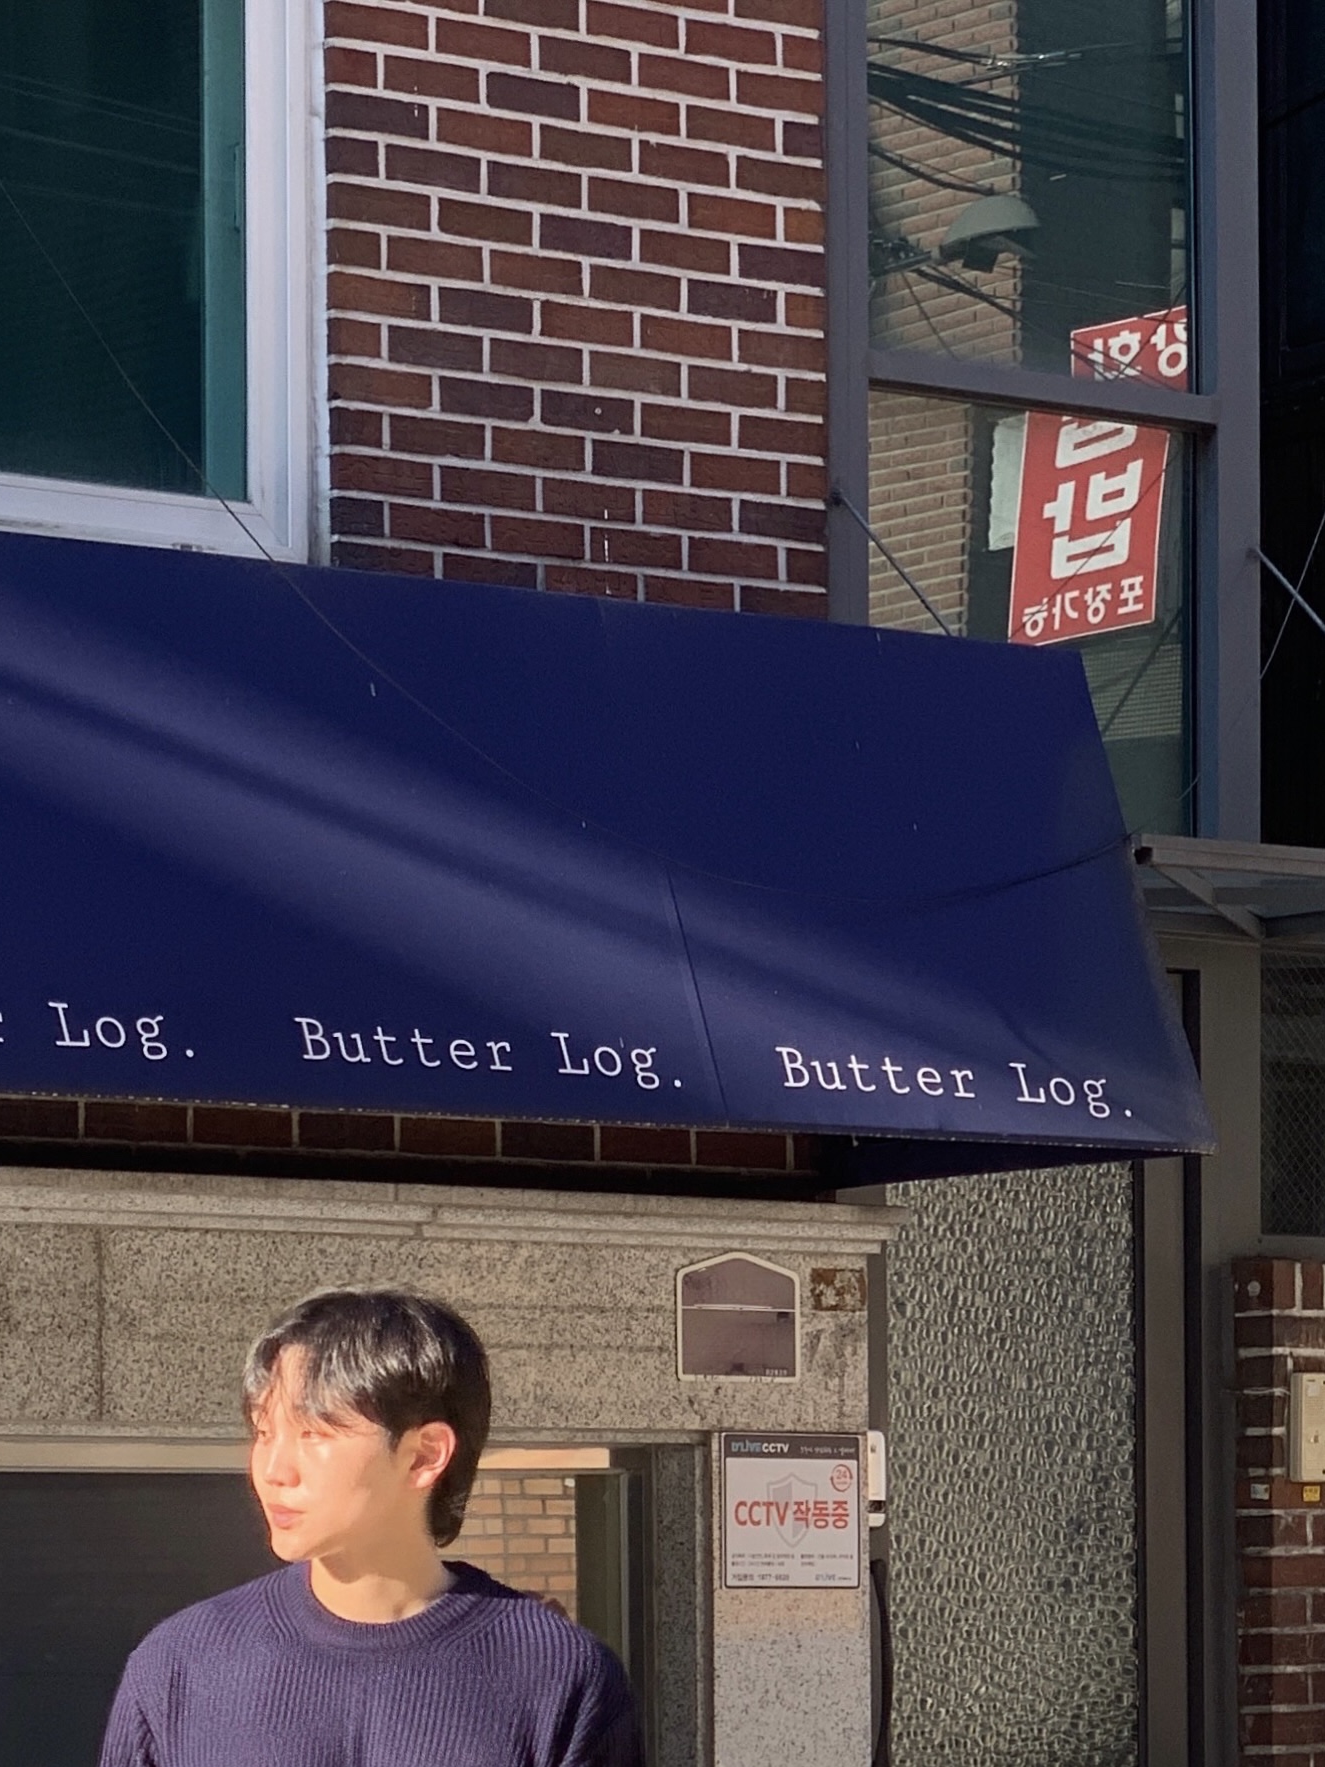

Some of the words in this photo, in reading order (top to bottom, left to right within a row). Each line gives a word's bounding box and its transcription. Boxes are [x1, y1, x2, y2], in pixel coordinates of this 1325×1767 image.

[48, 1001, 197, 1060] Log.
[294, 1017, 513, 1071] Butter
[550, 1031, 683, 1089] Log.
[775, 1046, 976, 1098] Butter
[1017, 1062, 1134, 1118] Log.
[762, 1443, 789, 1453] CCTV
[836, 1469, 847, 1480] 24
[734, 1501, 789, 1526] CCTV
[793, 1499, 849, 1529] 작동중
